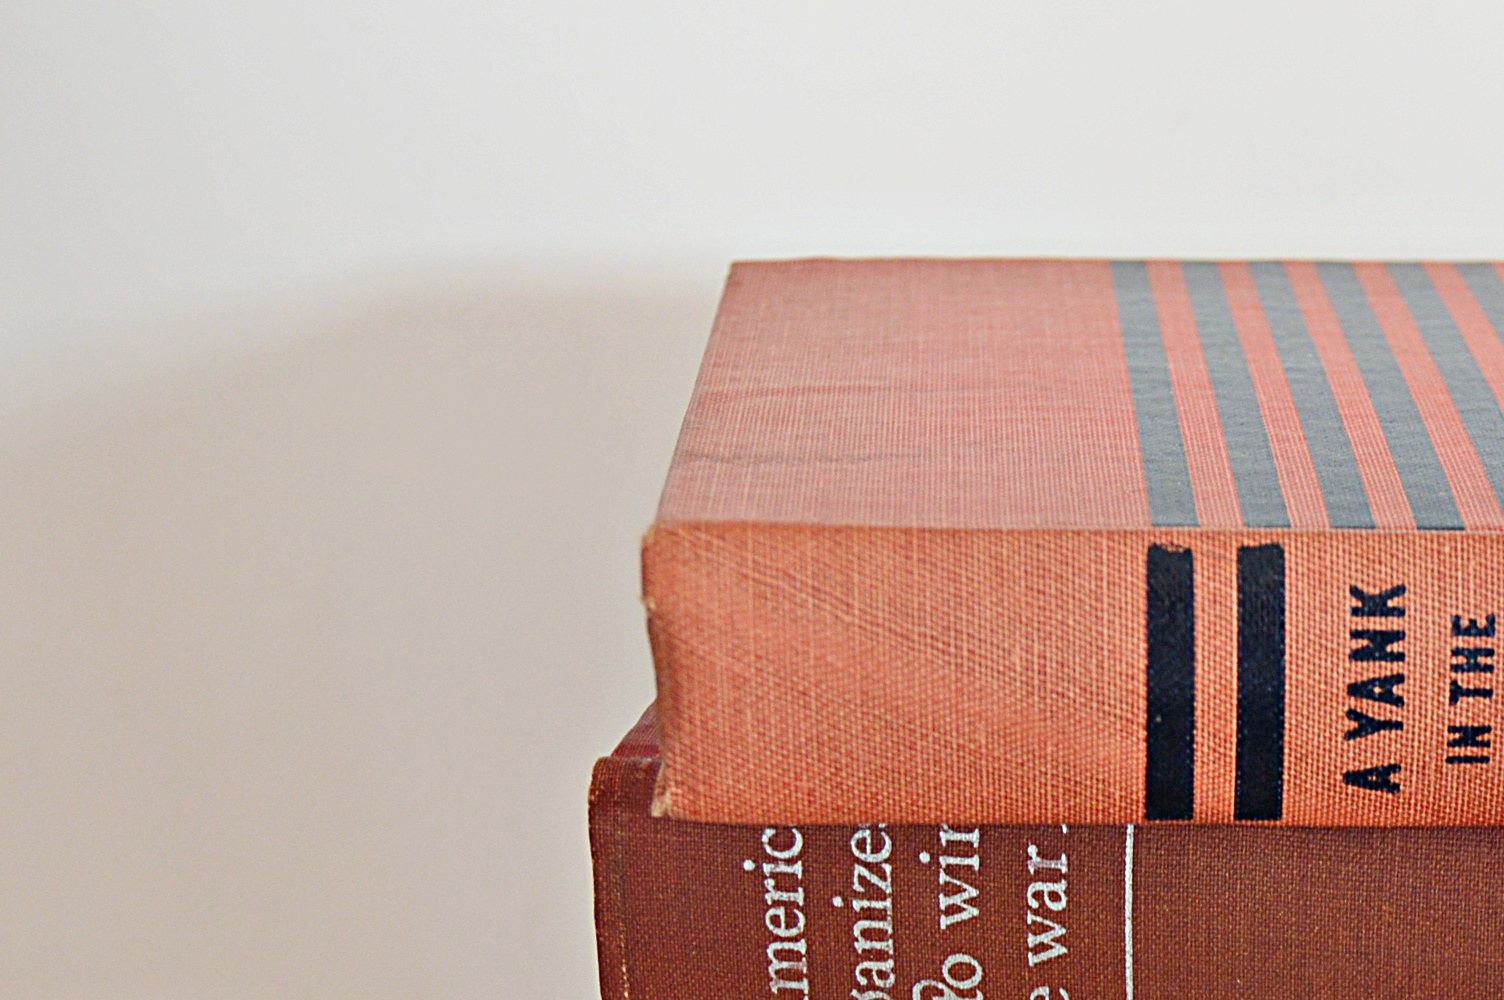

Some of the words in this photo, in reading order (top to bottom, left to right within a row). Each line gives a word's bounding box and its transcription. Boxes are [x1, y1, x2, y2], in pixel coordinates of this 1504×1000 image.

[1345, 583, 1407, 742] YANK
[1451, 613, 1497, 706] THE
[1343, 763, 1400, 795] A
[1446, 721, 1491, 765] IN
[1026, 844, 1069, 967] war
